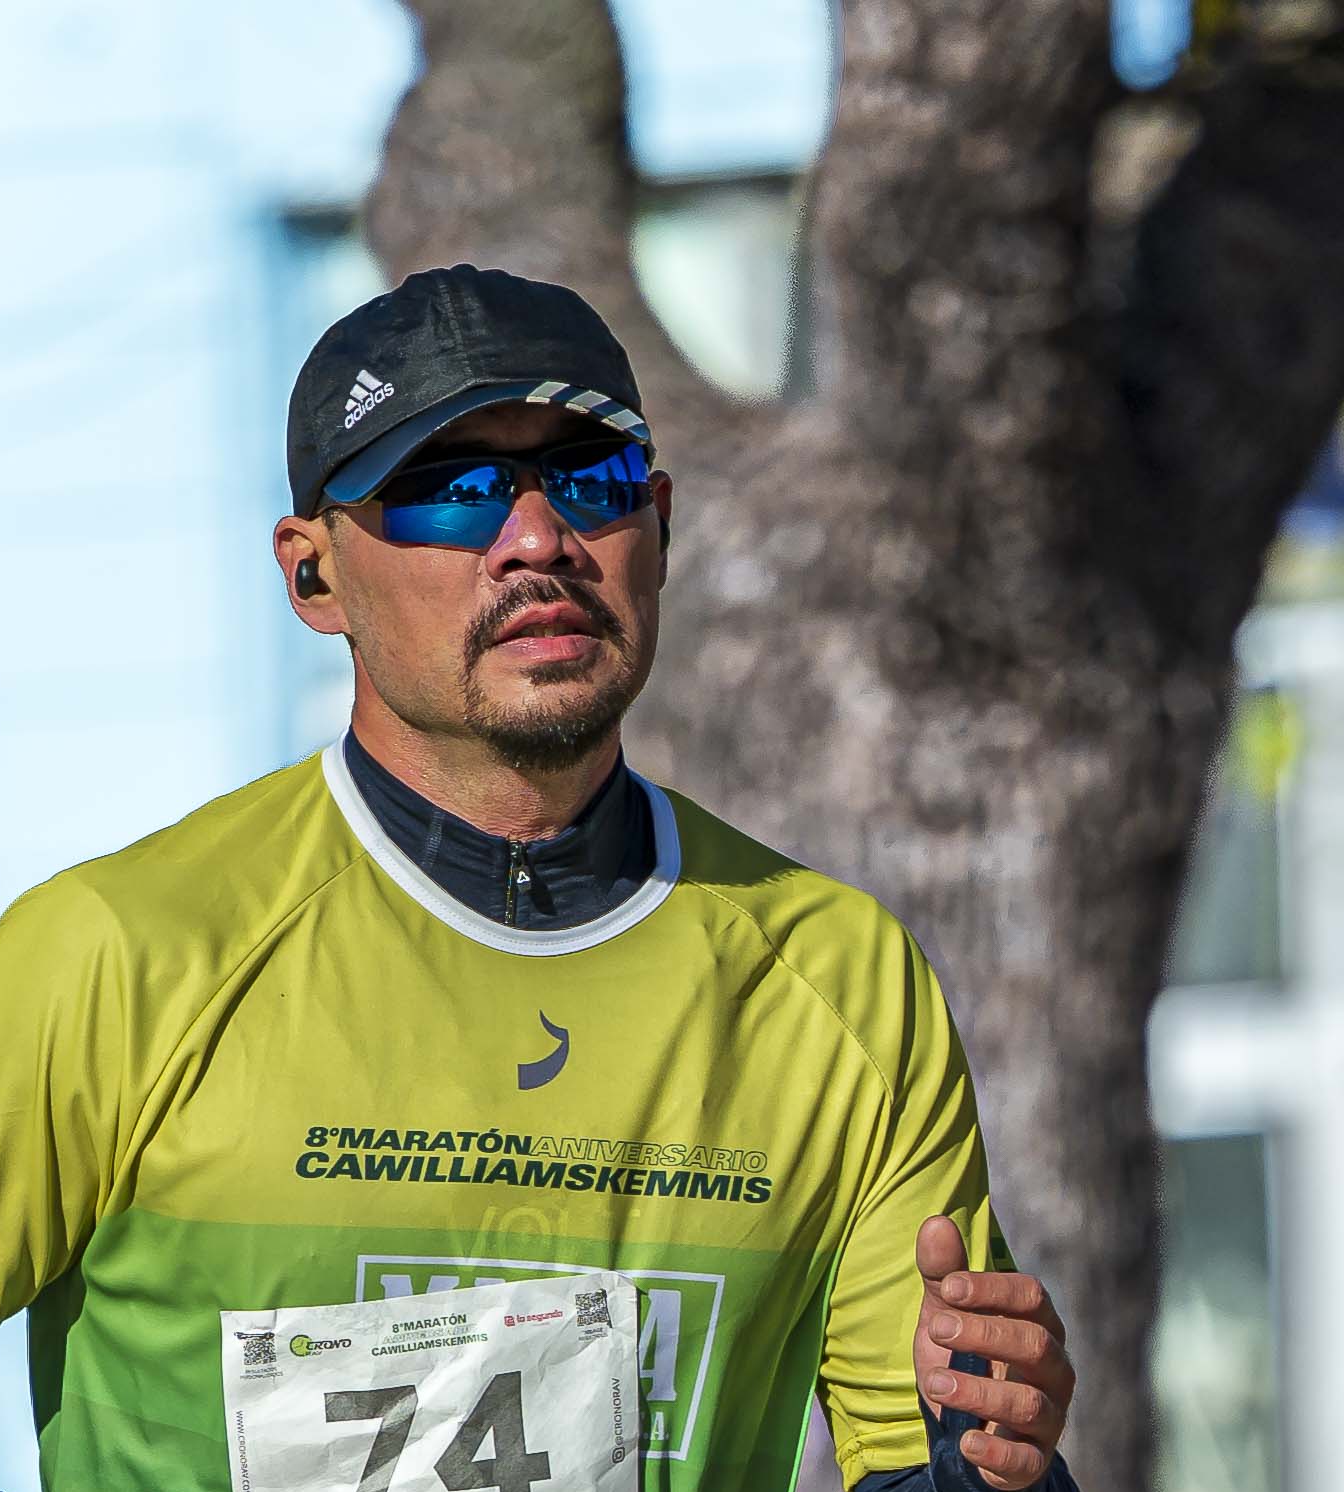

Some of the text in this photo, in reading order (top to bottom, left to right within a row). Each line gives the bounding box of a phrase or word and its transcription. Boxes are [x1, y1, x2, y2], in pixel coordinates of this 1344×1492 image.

[344, 382, 395, 430] adidas
[295, 1151, 773, 1204] CAWILLIAMSKEMMIS
[530, 1136, 768, 1174] ANIVERSARIO
